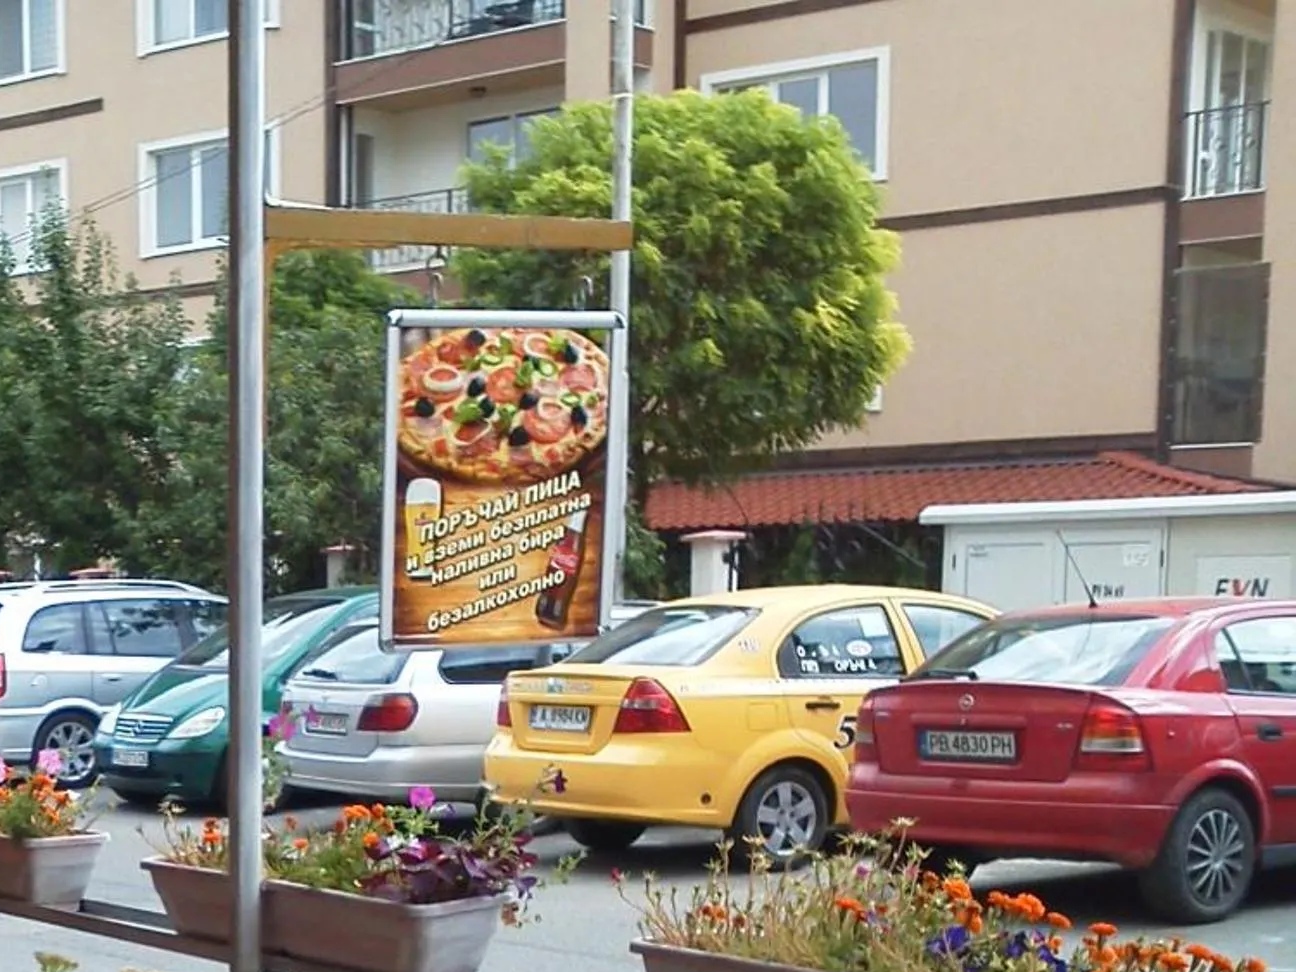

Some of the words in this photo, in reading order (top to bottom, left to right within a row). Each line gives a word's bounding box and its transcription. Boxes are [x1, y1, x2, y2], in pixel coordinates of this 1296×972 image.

[406, 555, 419, 573] и
[424, 533, 485, 564] вземи
[489, 491, 592, 539] безплатна
[419, 490, 520, 544] ПОРЪЧАЙ
[524, 470, 582, 506] ПИЦА
[431, 541, 514, 586] наливна
[519, 524, 566, 553] бира
[479, 564, 517, 591] или
[427, 568, 566, 632] безалкохолно
[833, 715, 857, 750] 5
